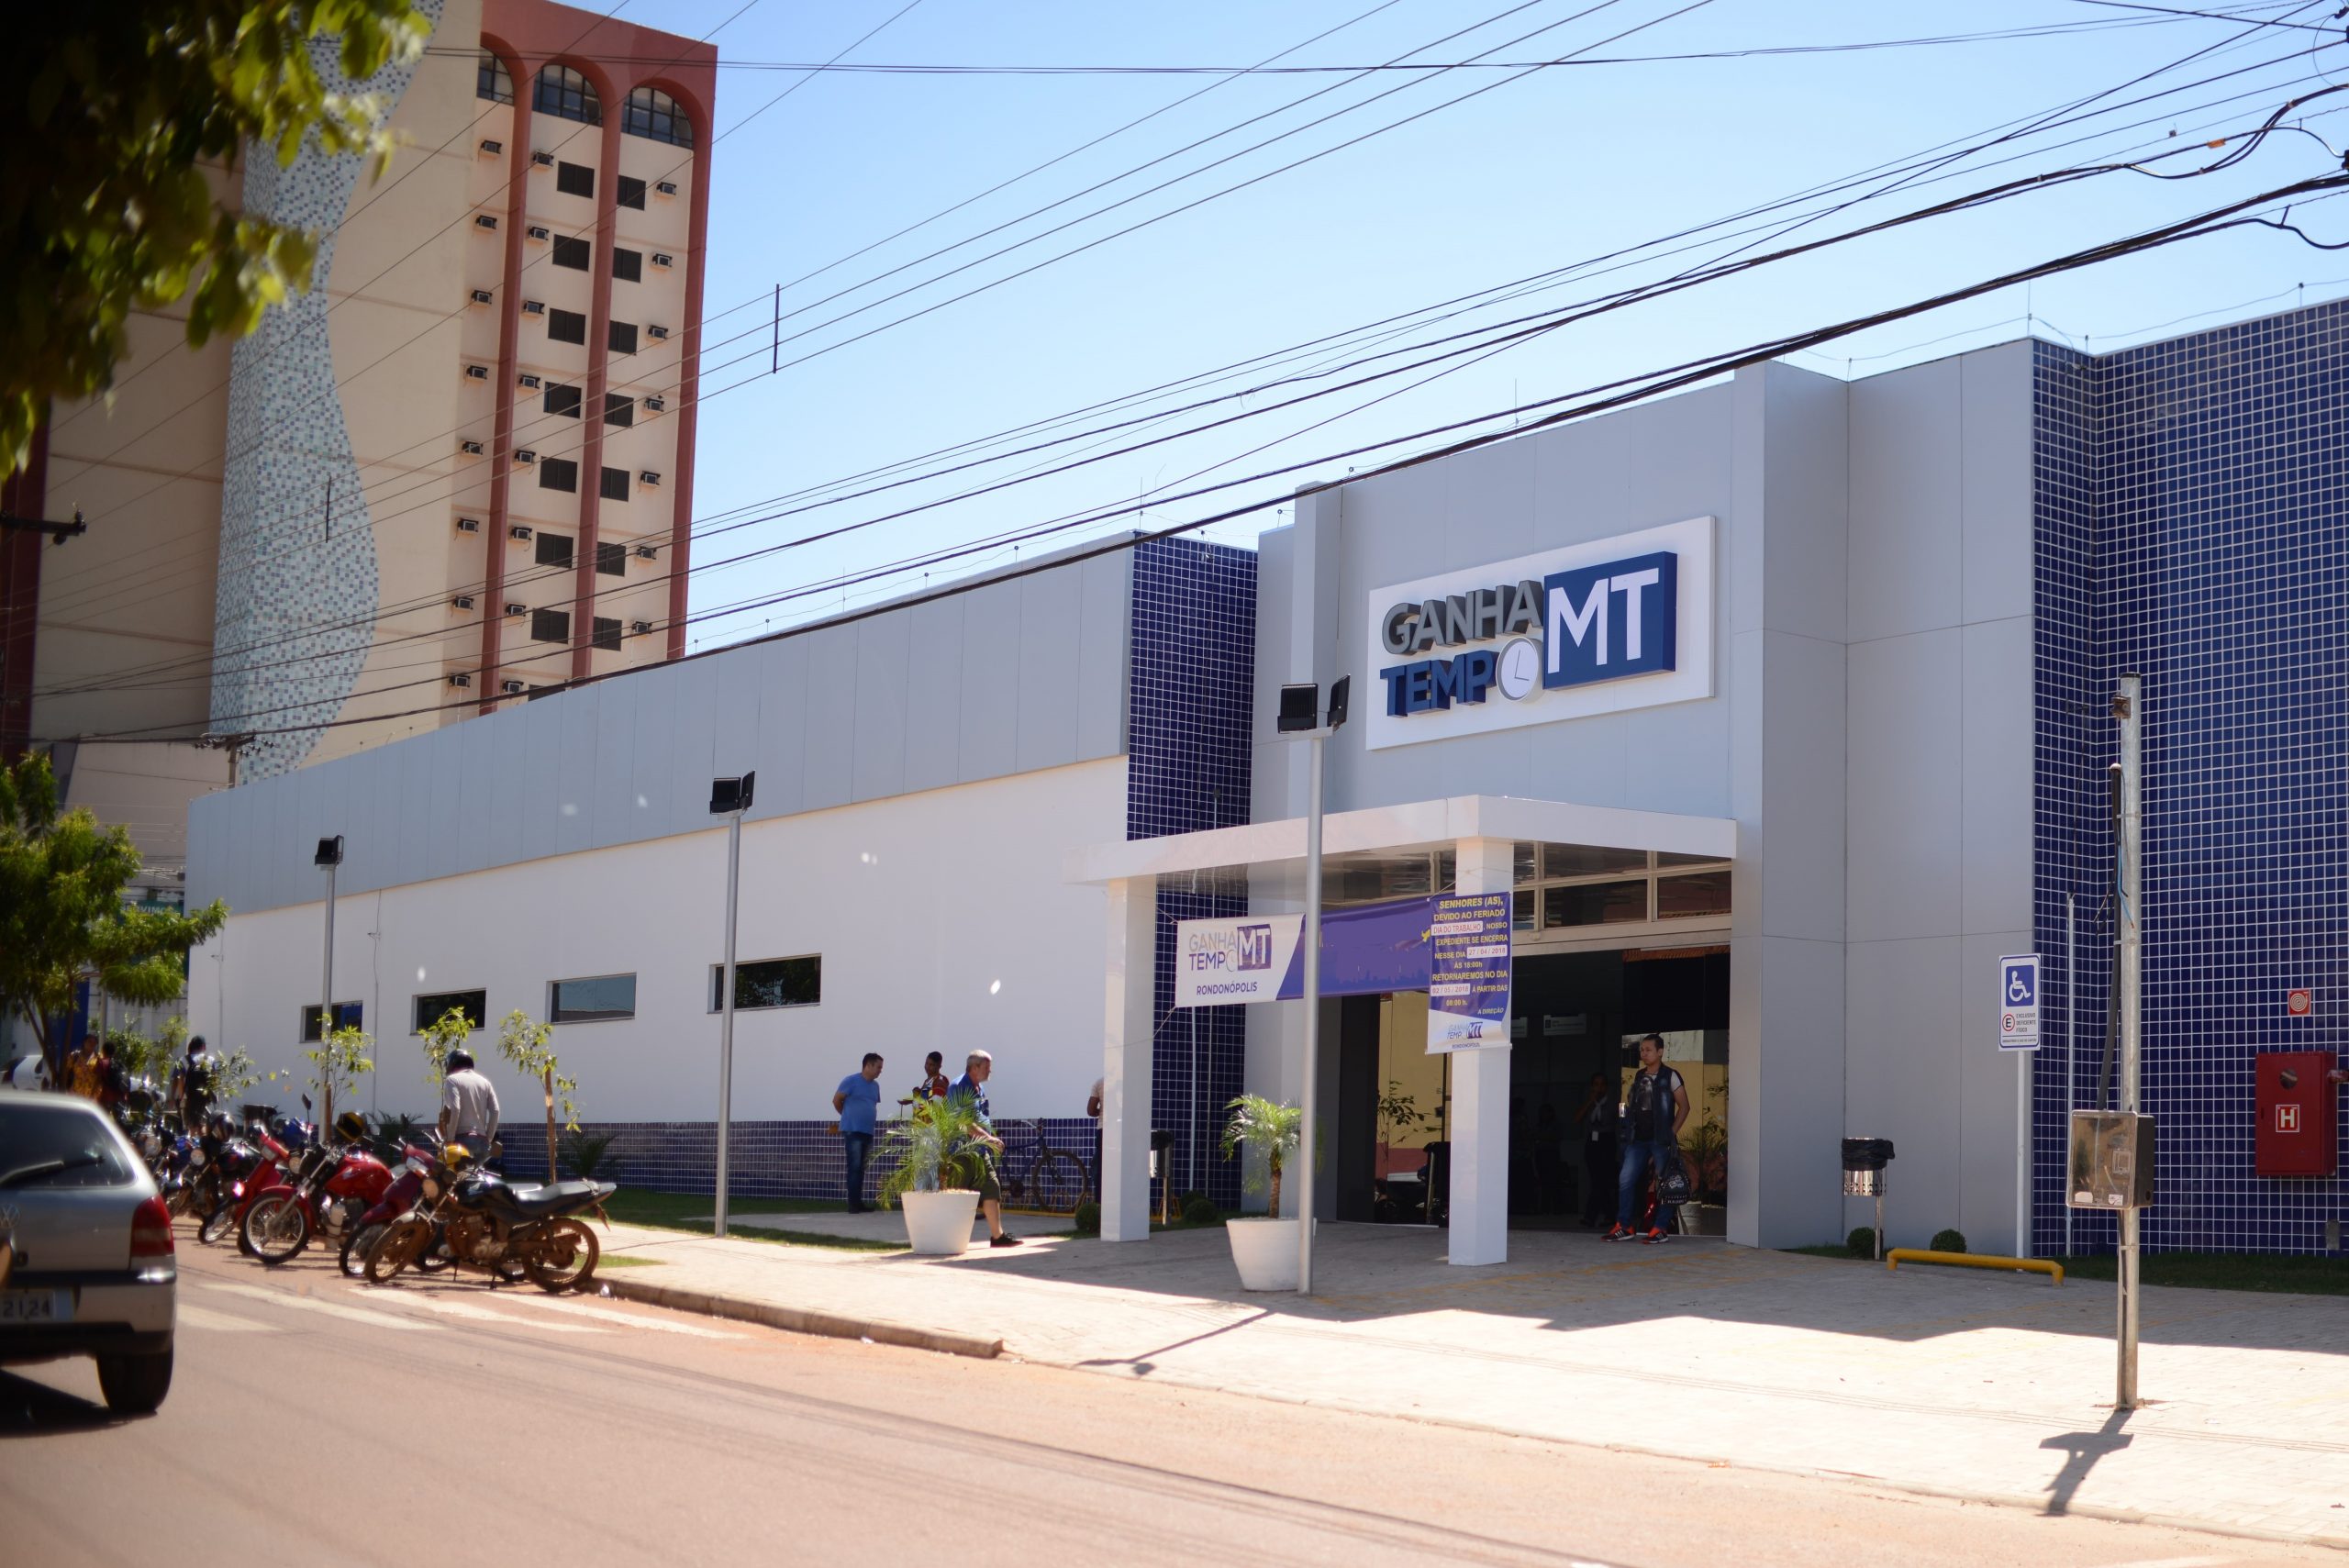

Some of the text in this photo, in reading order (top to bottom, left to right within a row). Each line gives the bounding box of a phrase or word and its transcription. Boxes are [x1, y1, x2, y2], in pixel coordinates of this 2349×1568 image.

[1382, 580, 1544, 655] GANHA
[1548, 567, 1660, 674] MT
[1439, 896, 1504, 909] SENHORES (AS),
[1433, 908, 1506, 922] DEVIDO AO FERIADO
[1433, 926, 1443, 934] DIA
[1453, 923, 1481, 933] TRABALHO
[1189, 930, 1237, 952] GANHA
[1436, 936, 1471, 946] EXPEDIENTE
[1480, 934, 1508, 943] ENCERRA
[1239, 928, 1271, 967] MT
[1434, 951, 1455, 960] NESSE
[1432, 971, 1485, 982] RETORNAREMOS
[1497, 970, 1508, 978] DIA
[1197, 980, 1258, 995] RONDONÓPOLIS
[1476, 984, 1497, 993] PARTIR
[1468, 1021, 1483, 1039] MT
[2006, 1018, 2011, 1028] E
[2280, 1108, 2295, 1128] H
